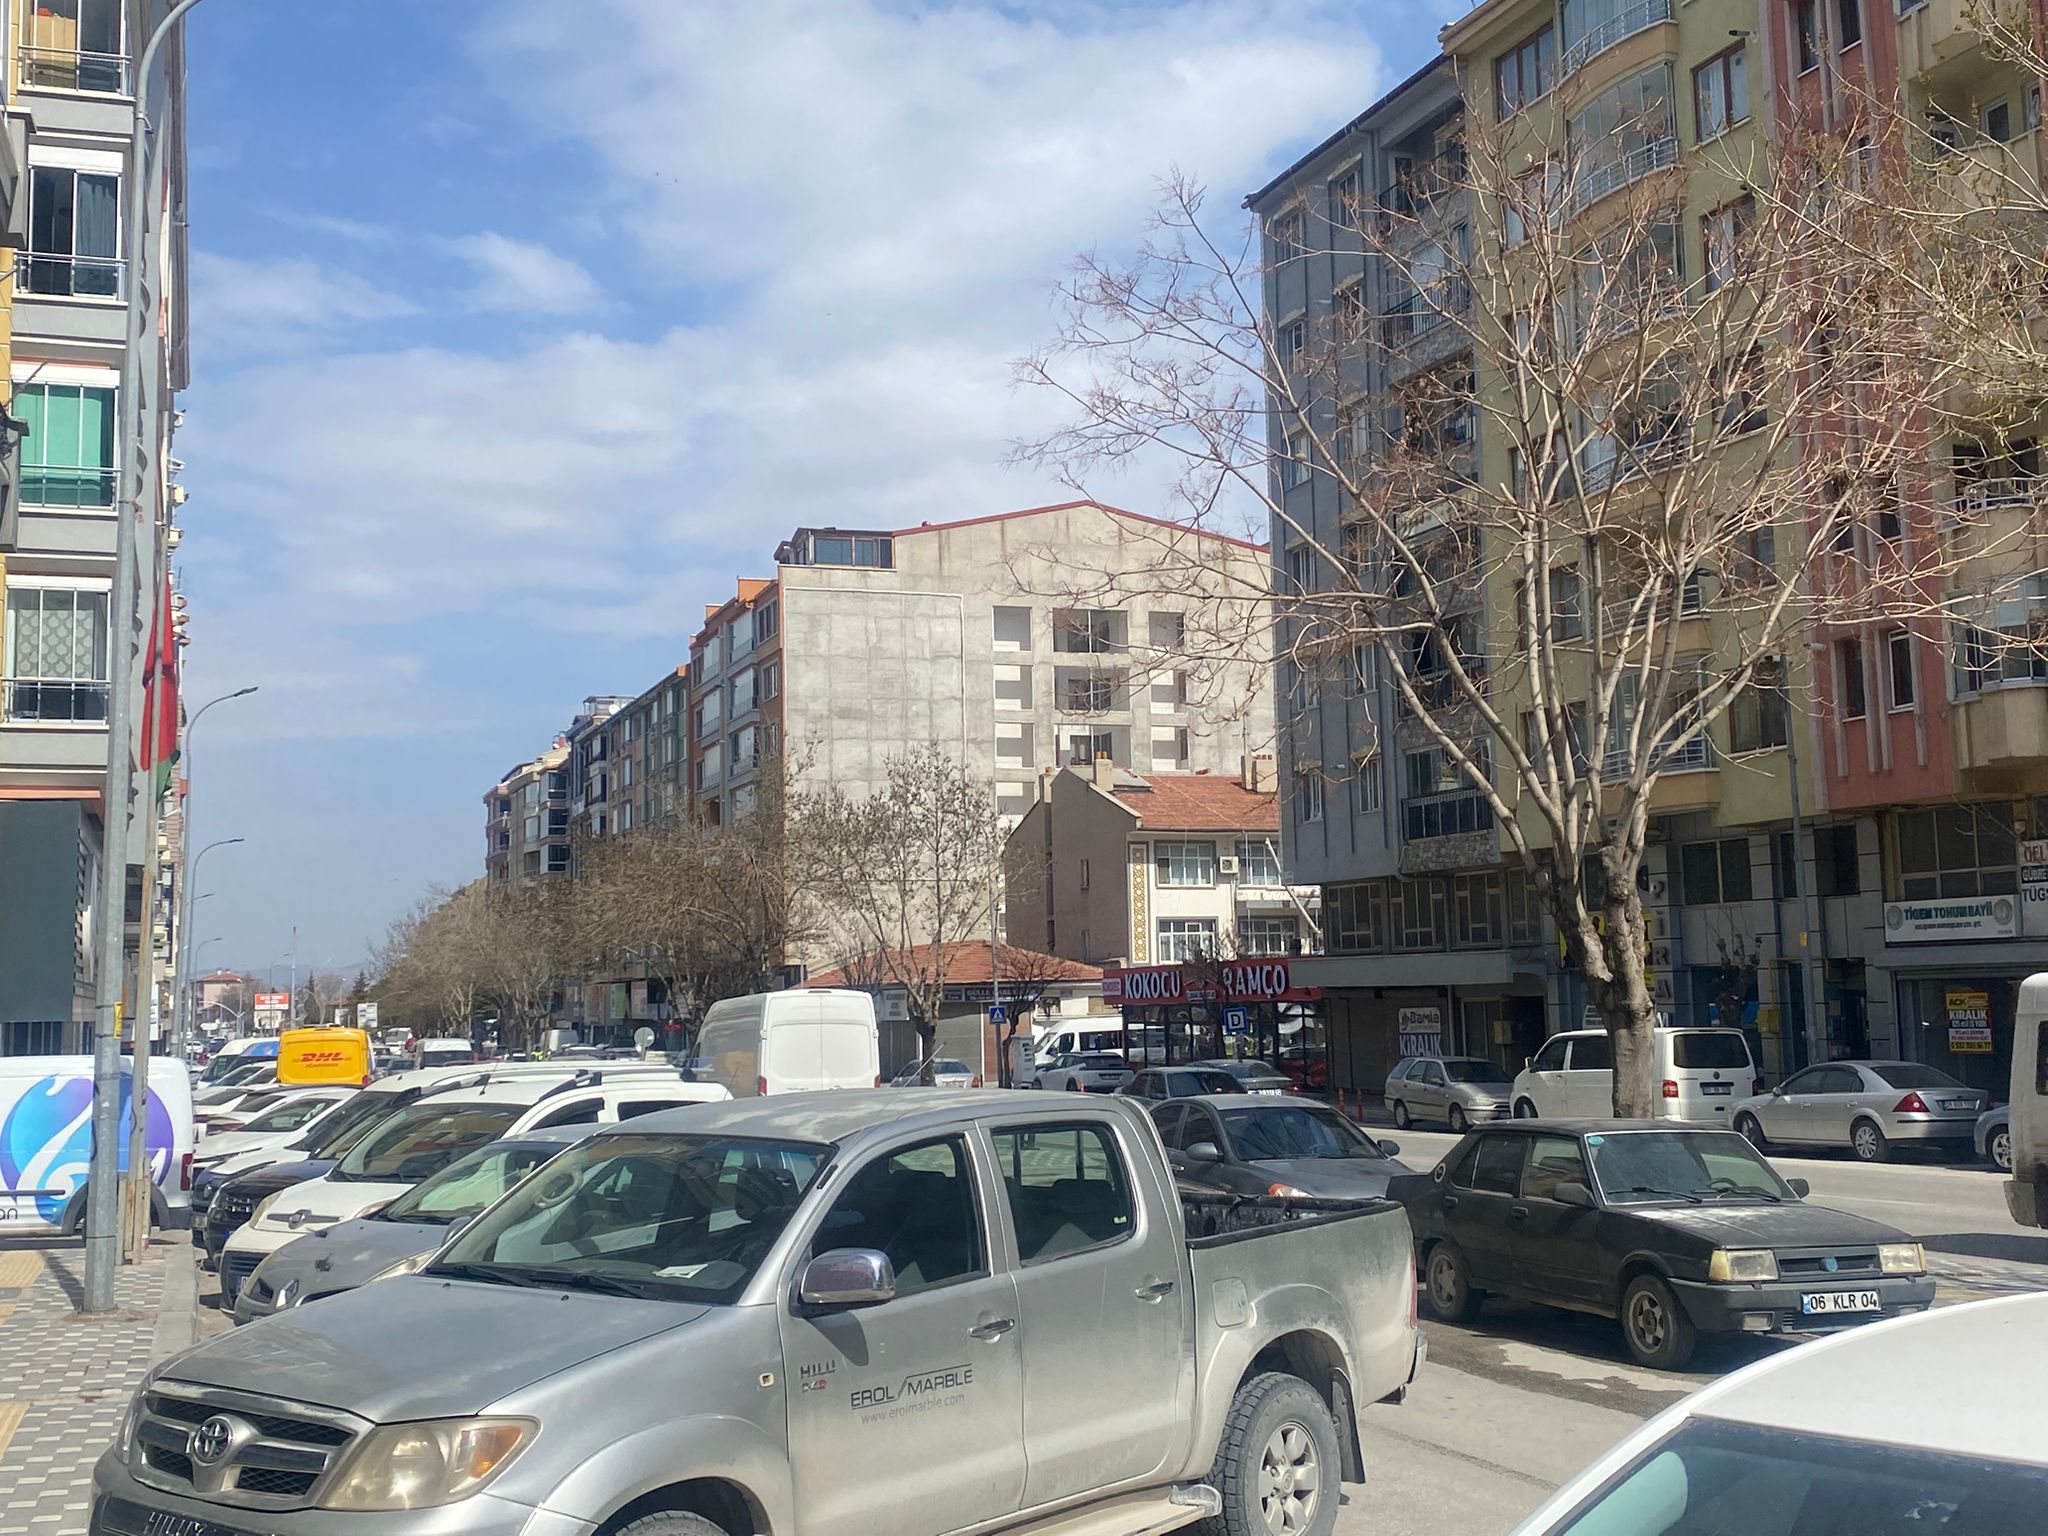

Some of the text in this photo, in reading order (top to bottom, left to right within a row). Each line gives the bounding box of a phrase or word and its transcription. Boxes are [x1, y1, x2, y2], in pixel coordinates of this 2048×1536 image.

[2022, 885, 2048, 902] TÜG
[301, 1052, 343, 1063] DHL
[1810, 1293, 1877, 1310] 06 KLR 04
[850, 1369, 973, 1407] EROL MARBLE
